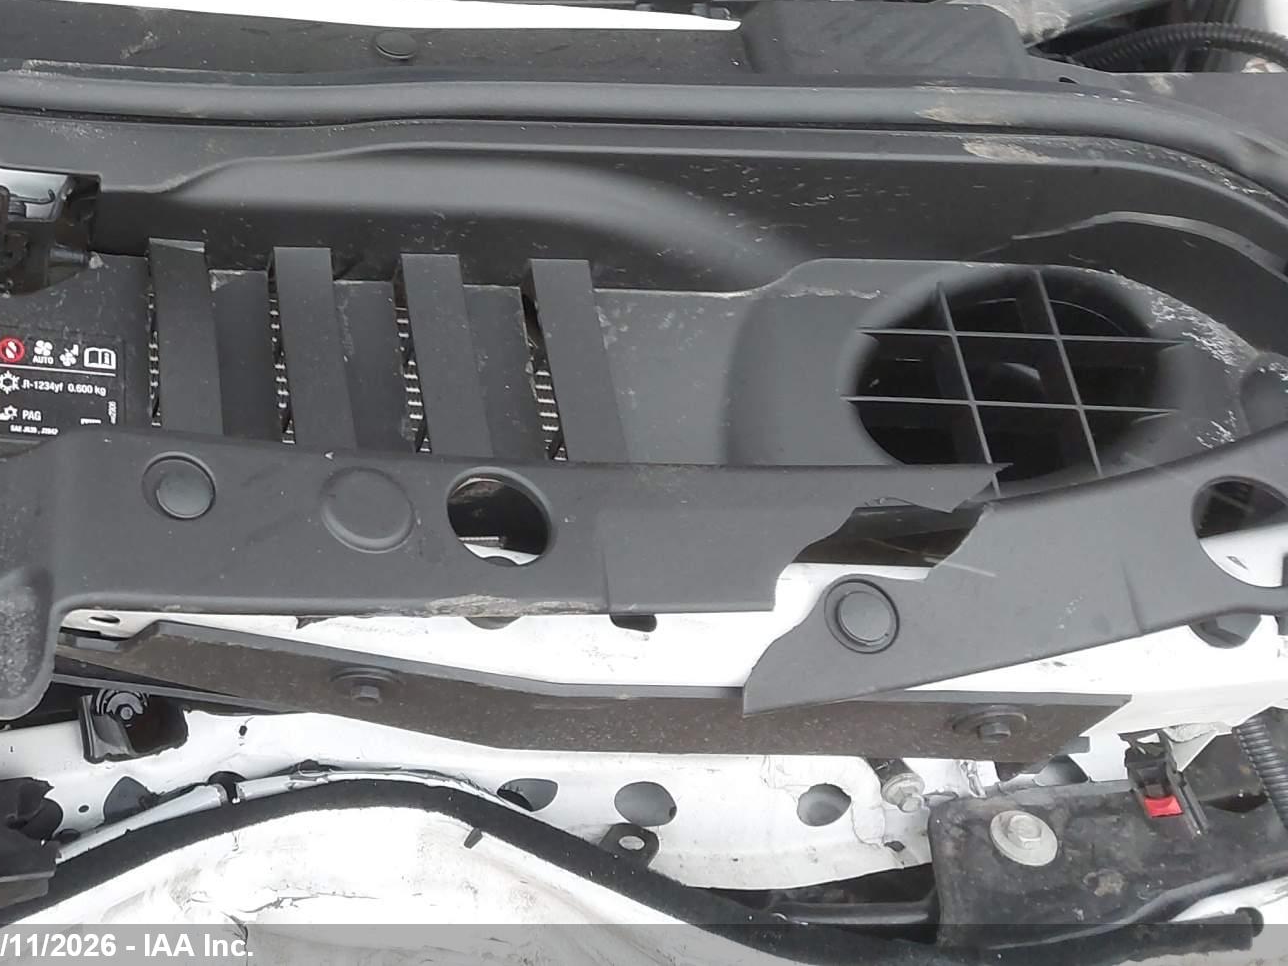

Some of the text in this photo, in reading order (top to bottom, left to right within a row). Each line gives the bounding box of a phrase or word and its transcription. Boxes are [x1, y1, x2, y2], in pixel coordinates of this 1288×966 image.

[32, 355, 54, 365] AUTO
[21, 378, 107, 397] R-1234yf 0.600 kg
[22, 409, 42, 421] PAG
